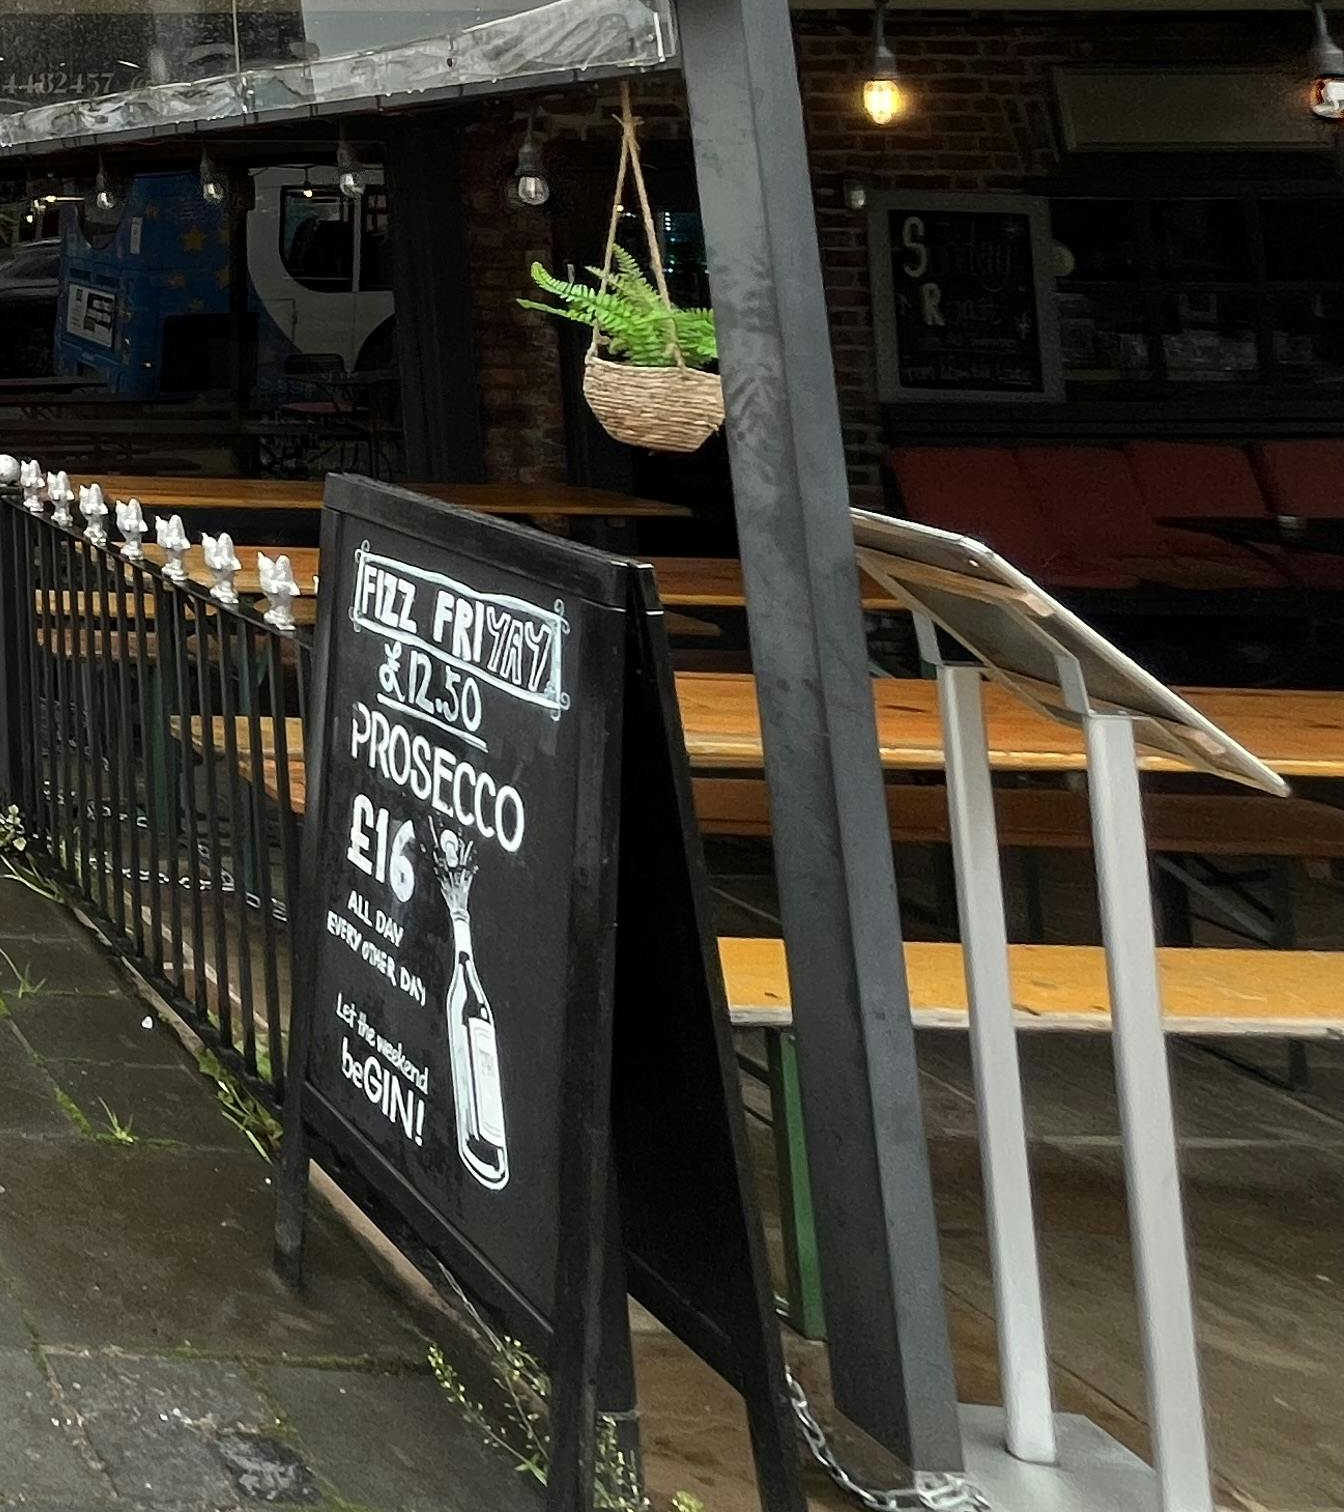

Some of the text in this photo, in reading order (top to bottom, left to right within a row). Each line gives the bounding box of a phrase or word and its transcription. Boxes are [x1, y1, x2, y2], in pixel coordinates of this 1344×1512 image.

[362, 564, 552, 692] FIZZ FRIYAY
[351, 701, 525, 853] PROSECCO
[346, 793, 416, 903] £16
[326, 910, 426, 1007] EVERY OTHER DAY
[347, 890, 405, 948] ALL DAY
[335, 992, 430, 1096] Let the weekend
[340, 1036, 425, 1147] beGIN!
